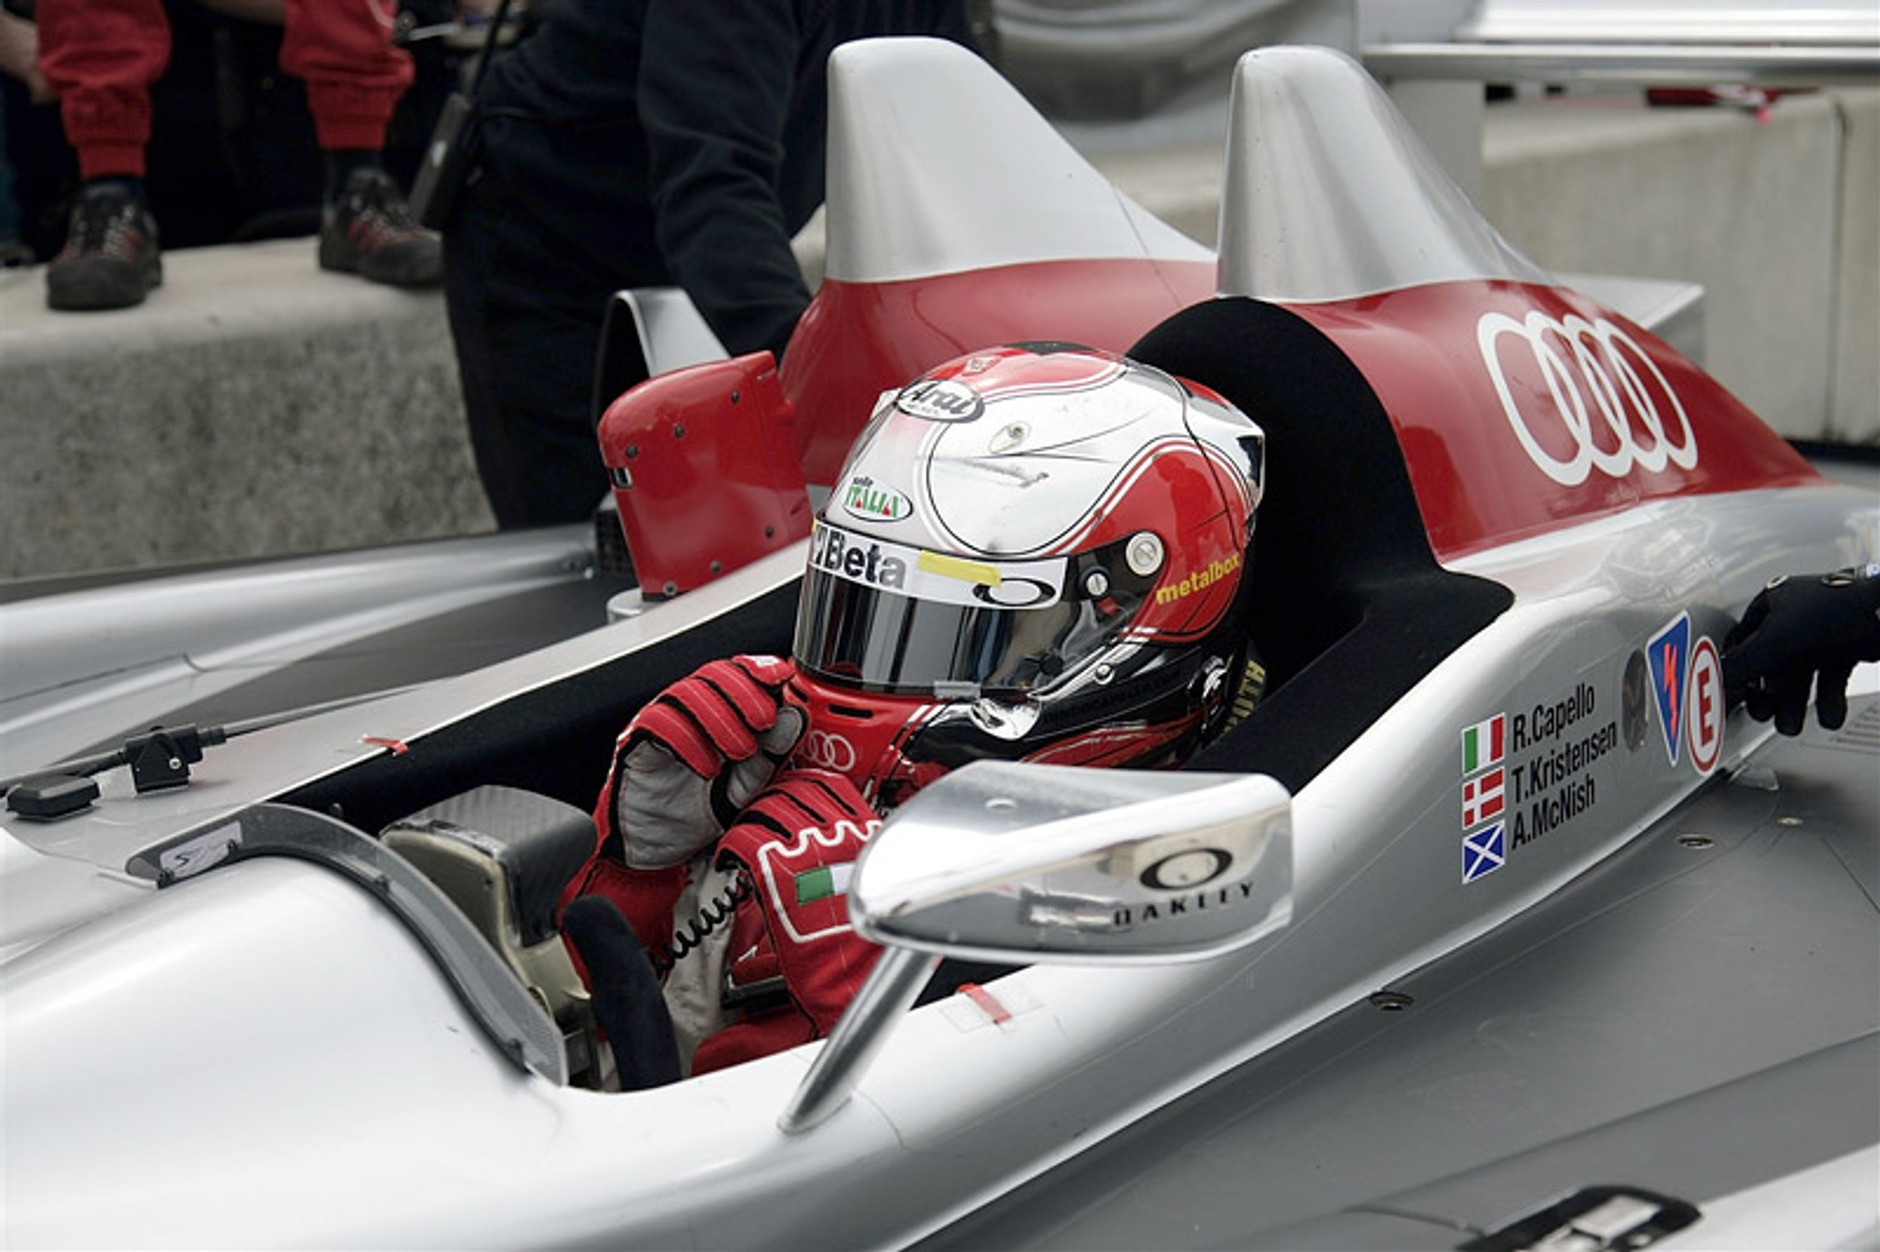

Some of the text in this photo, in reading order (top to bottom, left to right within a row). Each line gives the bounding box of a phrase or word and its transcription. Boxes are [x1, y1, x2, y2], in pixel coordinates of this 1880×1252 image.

[902, 381, 977, 414] Arai
[844, 485, 899, 518] ITALIA
[823, 529, 906, 590] Beta
[1155, 551, 1240, 605] metalbox
[1512, 682, 1596, 753] R.Capello
[1511, 720, 1618, 804] T.Kristensen
[1511, 773, 1596, 850] A.McNish
[1113, 880, 1254, 927] OAKLEY
